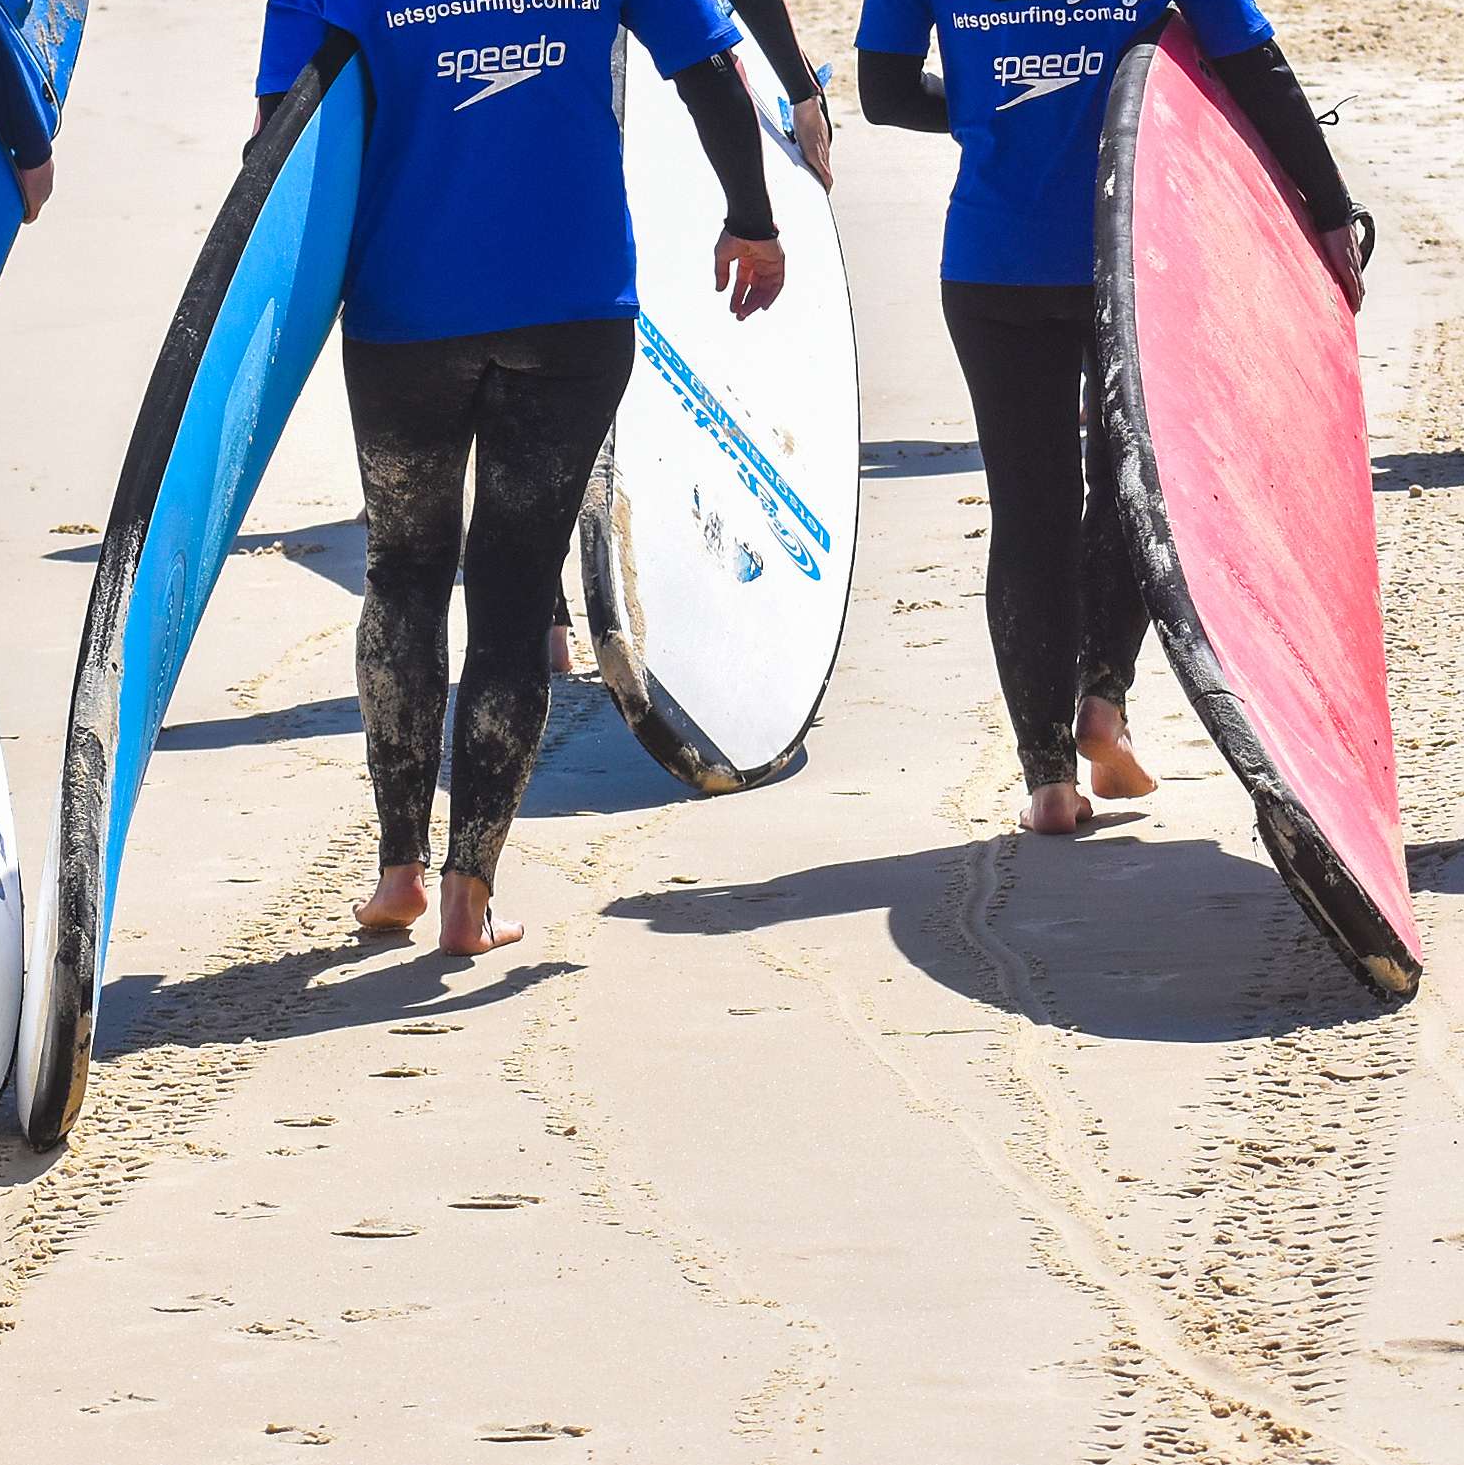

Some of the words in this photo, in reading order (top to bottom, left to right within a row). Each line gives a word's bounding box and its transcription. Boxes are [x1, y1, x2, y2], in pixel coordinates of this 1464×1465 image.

[953, 6, 1137, 31] letsgosurfing.comau
[437, 34, 566, 83] speedo
[993, 45, 1104, 87] speedo
